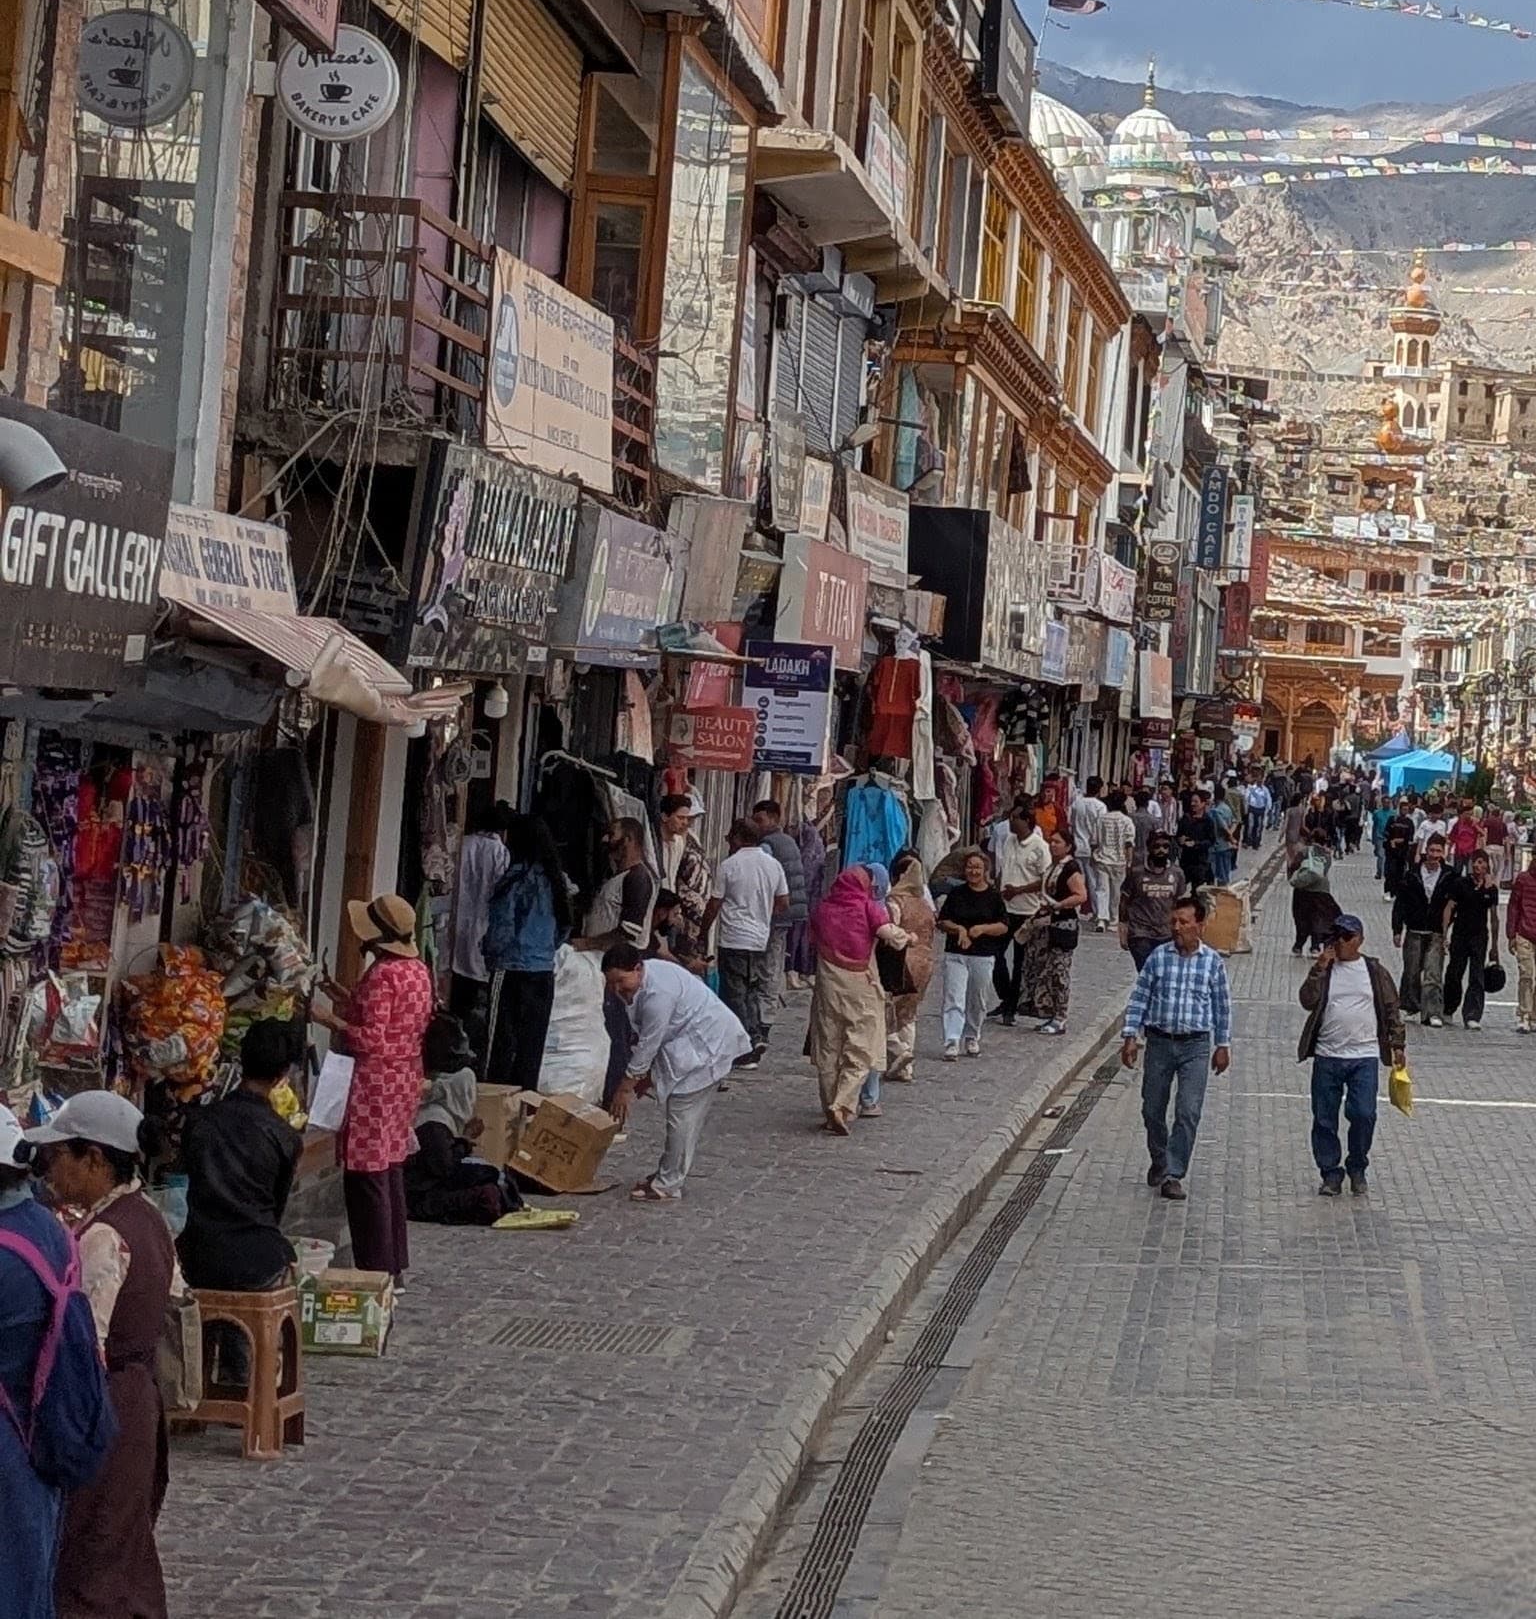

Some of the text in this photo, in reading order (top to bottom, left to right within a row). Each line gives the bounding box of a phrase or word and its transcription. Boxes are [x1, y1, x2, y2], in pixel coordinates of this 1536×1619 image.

[290, 92, 381, 126] BAKERY & CAFE
[1203, 469, 1221, 567] AMDO CAFE
[2, 505, 66, 589] GIFT
[63, 518, 162, 605] GALLERY
[199, 535, 249, 588] GENERAL
[248, 546, 289, 593] STORE
[765, 657, 810, 676] LADAKH
[695, 715, 754, 733] BEAUTY
[696, 731, 747, 749] SALON
